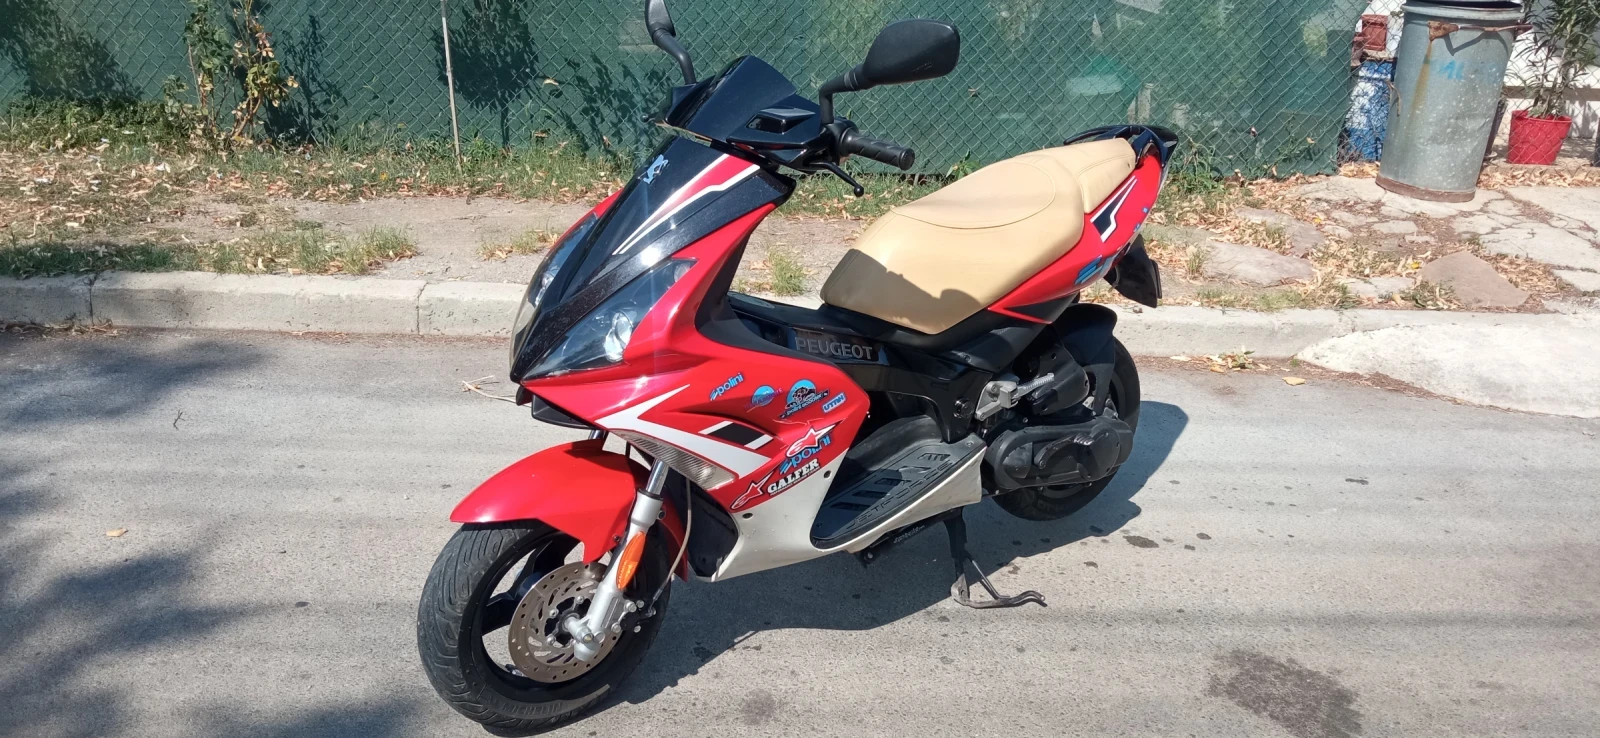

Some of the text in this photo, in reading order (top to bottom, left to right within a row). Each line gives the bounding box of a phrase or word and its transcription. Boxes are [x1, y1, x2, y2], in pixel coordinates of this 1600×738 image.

[794, 336, 873, 360] PEUGEOT
[715, 371, 744, 397] polini
[767, 458, 820, 494] GALFER
